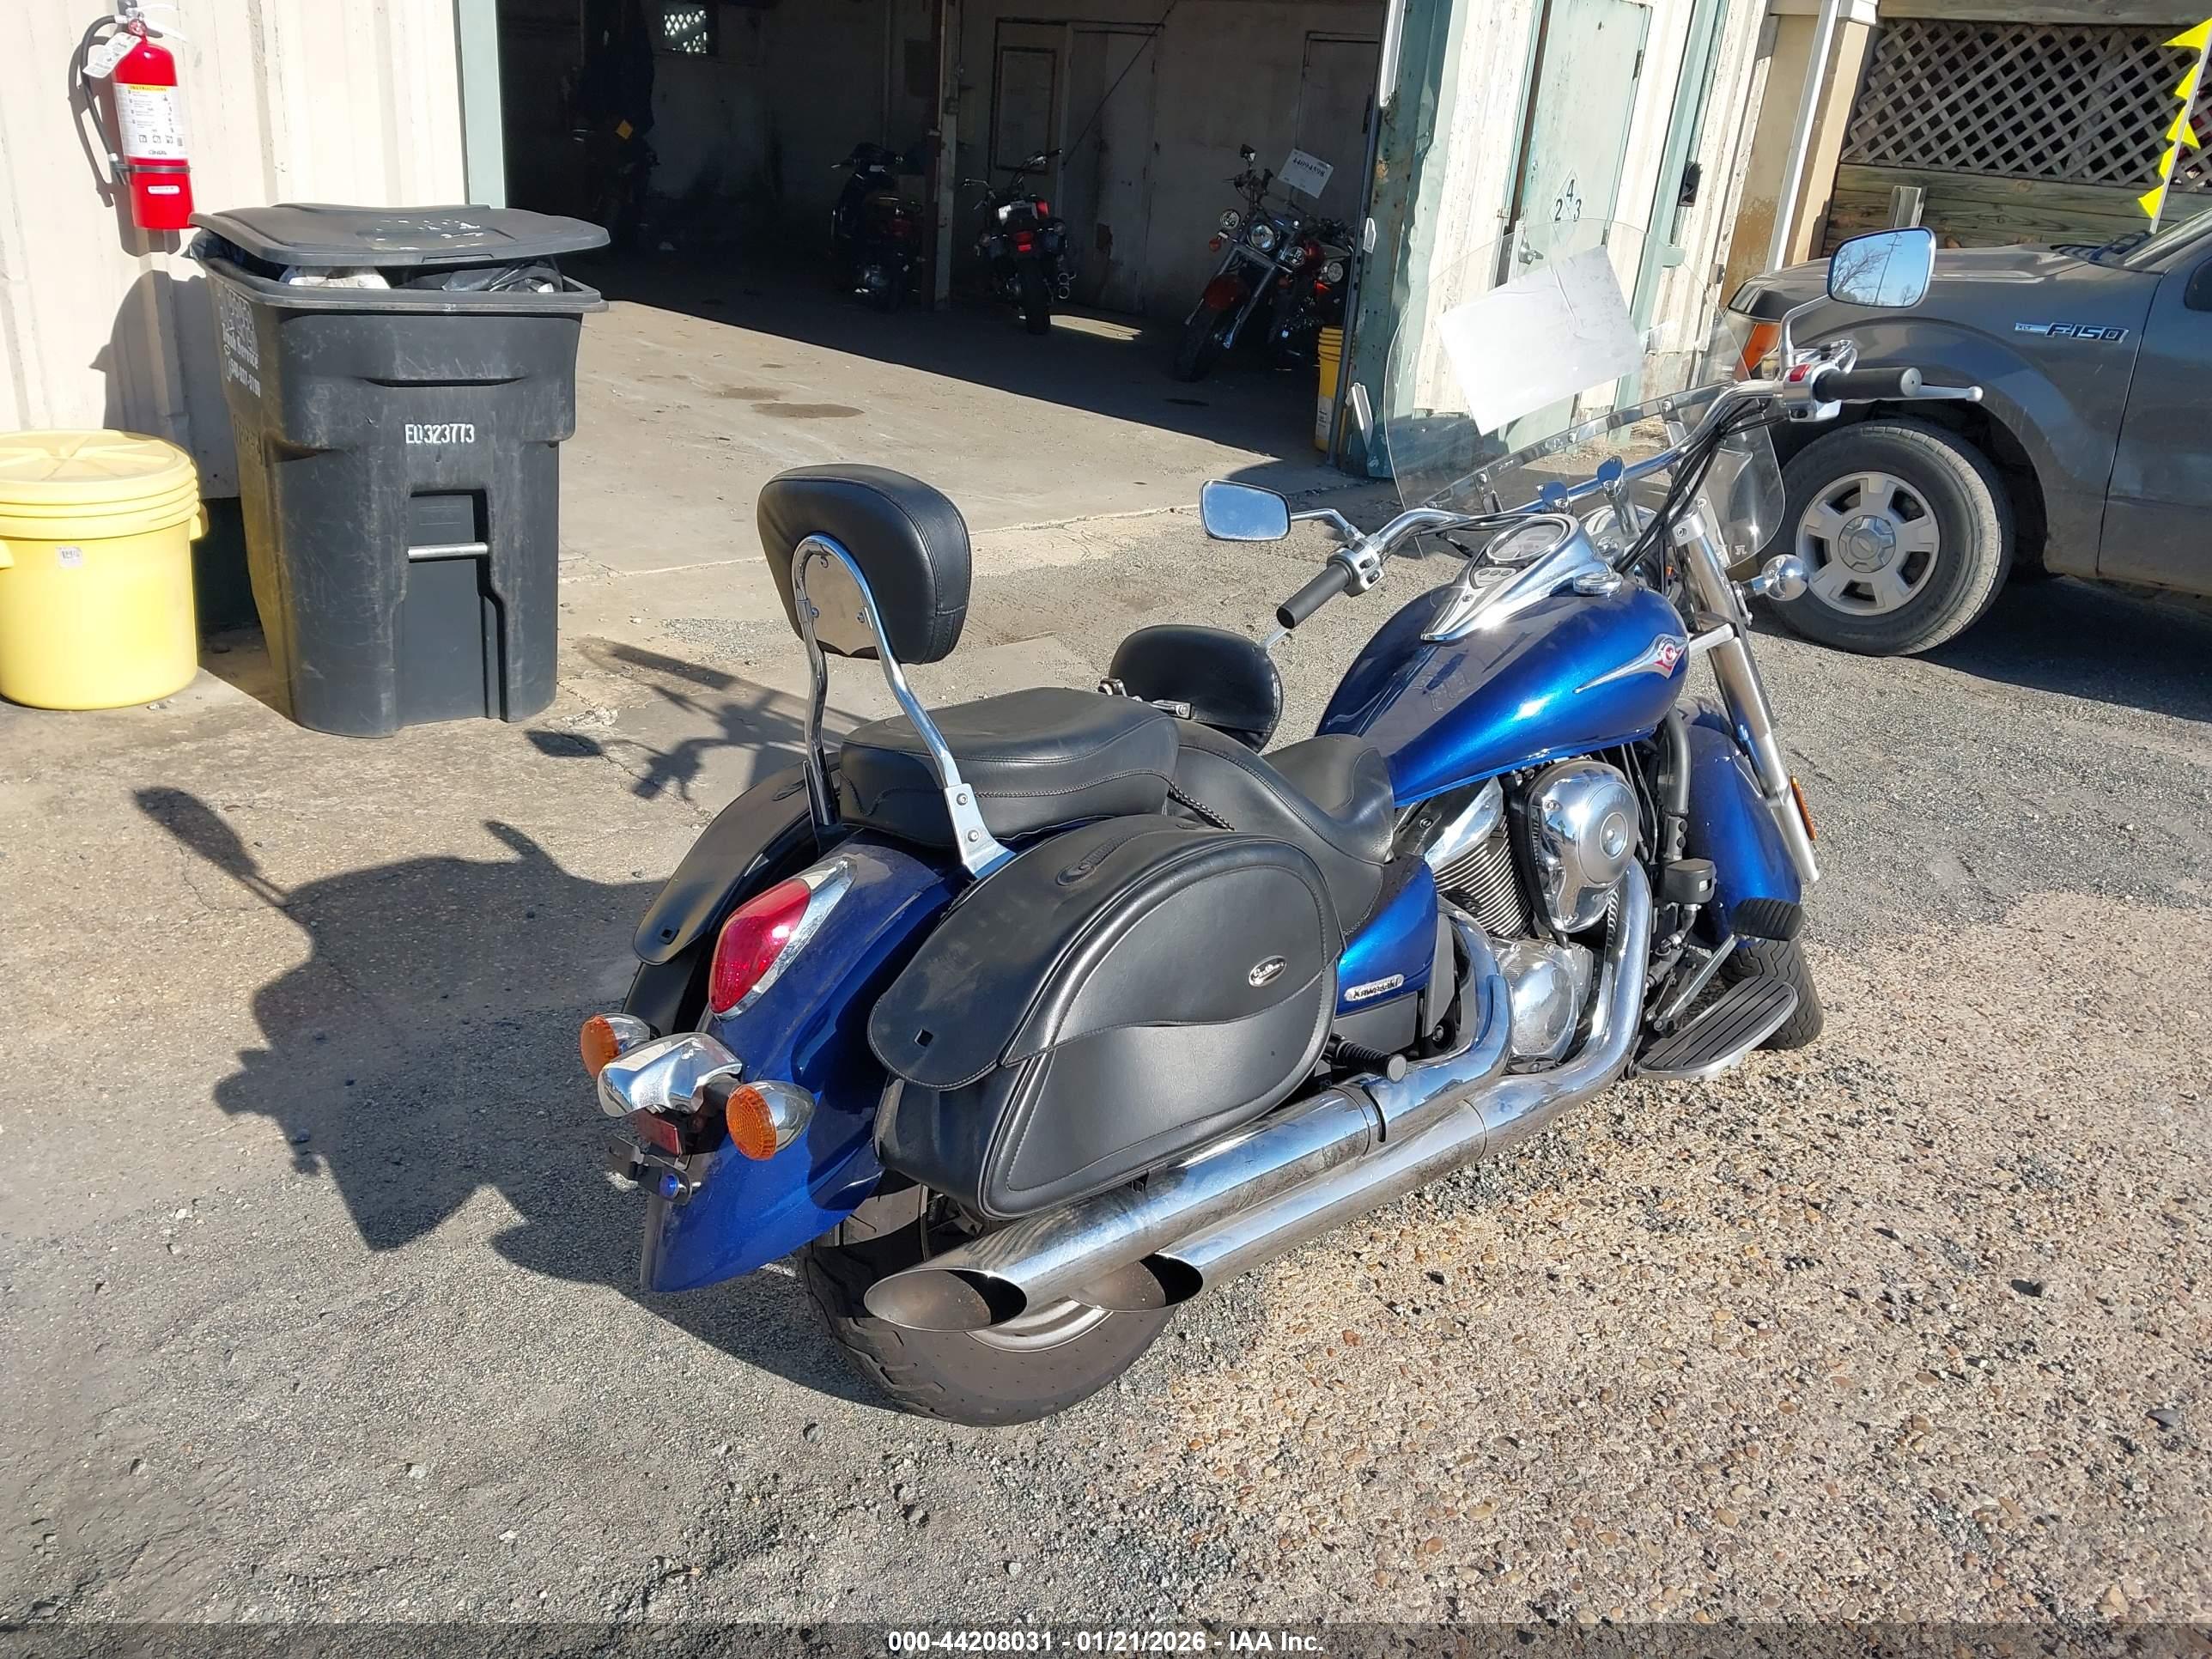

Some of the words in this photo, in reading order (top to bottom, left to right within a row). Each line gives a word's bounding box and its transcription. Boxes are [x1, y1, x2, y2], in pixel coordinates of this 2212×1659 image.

[1566, 179, 1575, 202] 4
[1555, 198, 1563, 221] 2
[1573, 198, 1582, 222] 3
[2045, 322, 2129, 343] F-150
